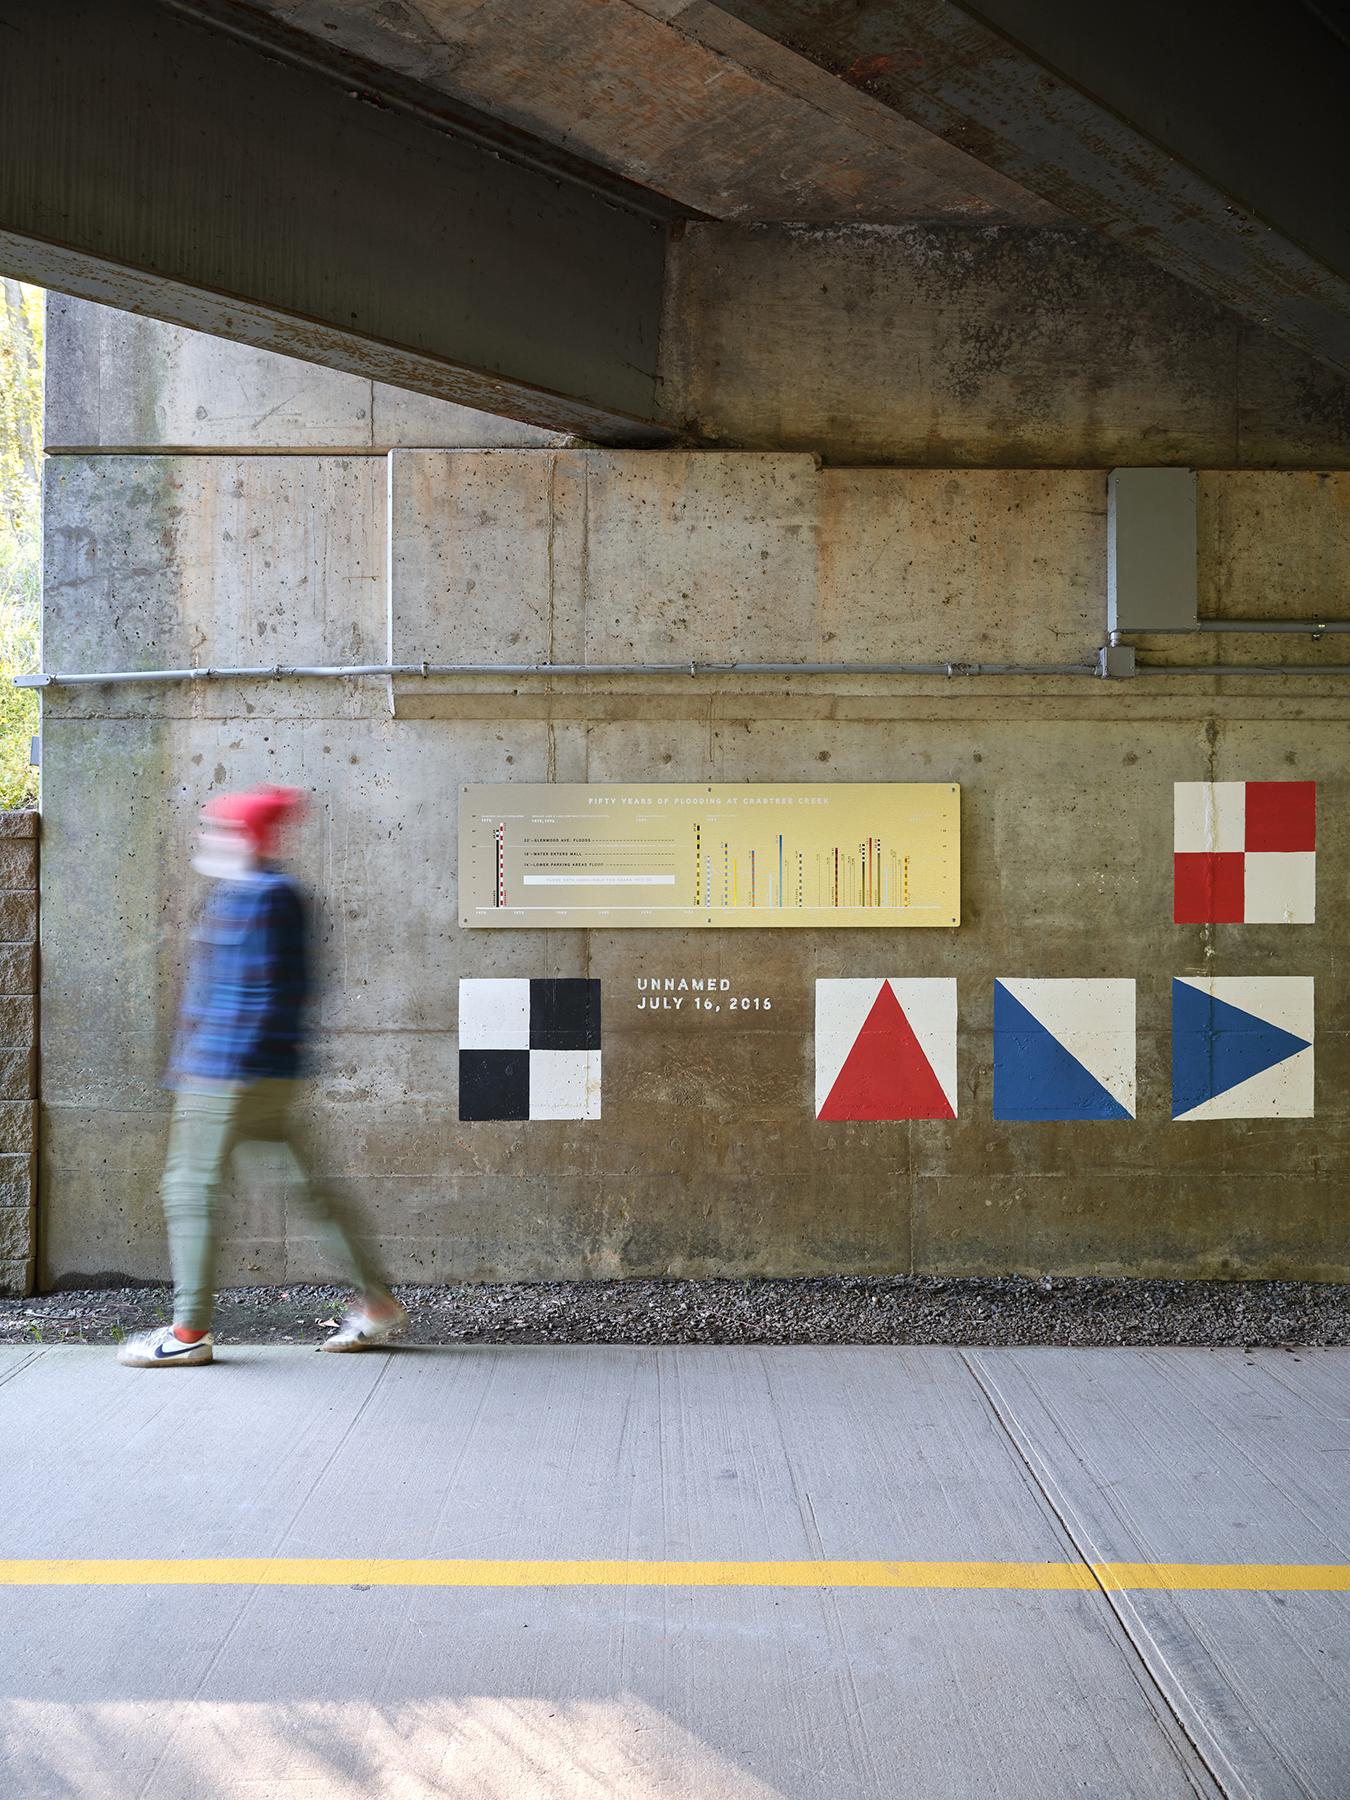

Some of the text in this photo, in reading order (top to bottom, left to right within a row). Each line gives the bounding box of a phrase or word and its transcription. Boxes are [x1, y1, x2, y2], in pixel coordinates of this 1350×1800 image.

[637, 978, 731, 991] UNNAMED
[636, 997, 772, 1012] JULY 16, 2016
